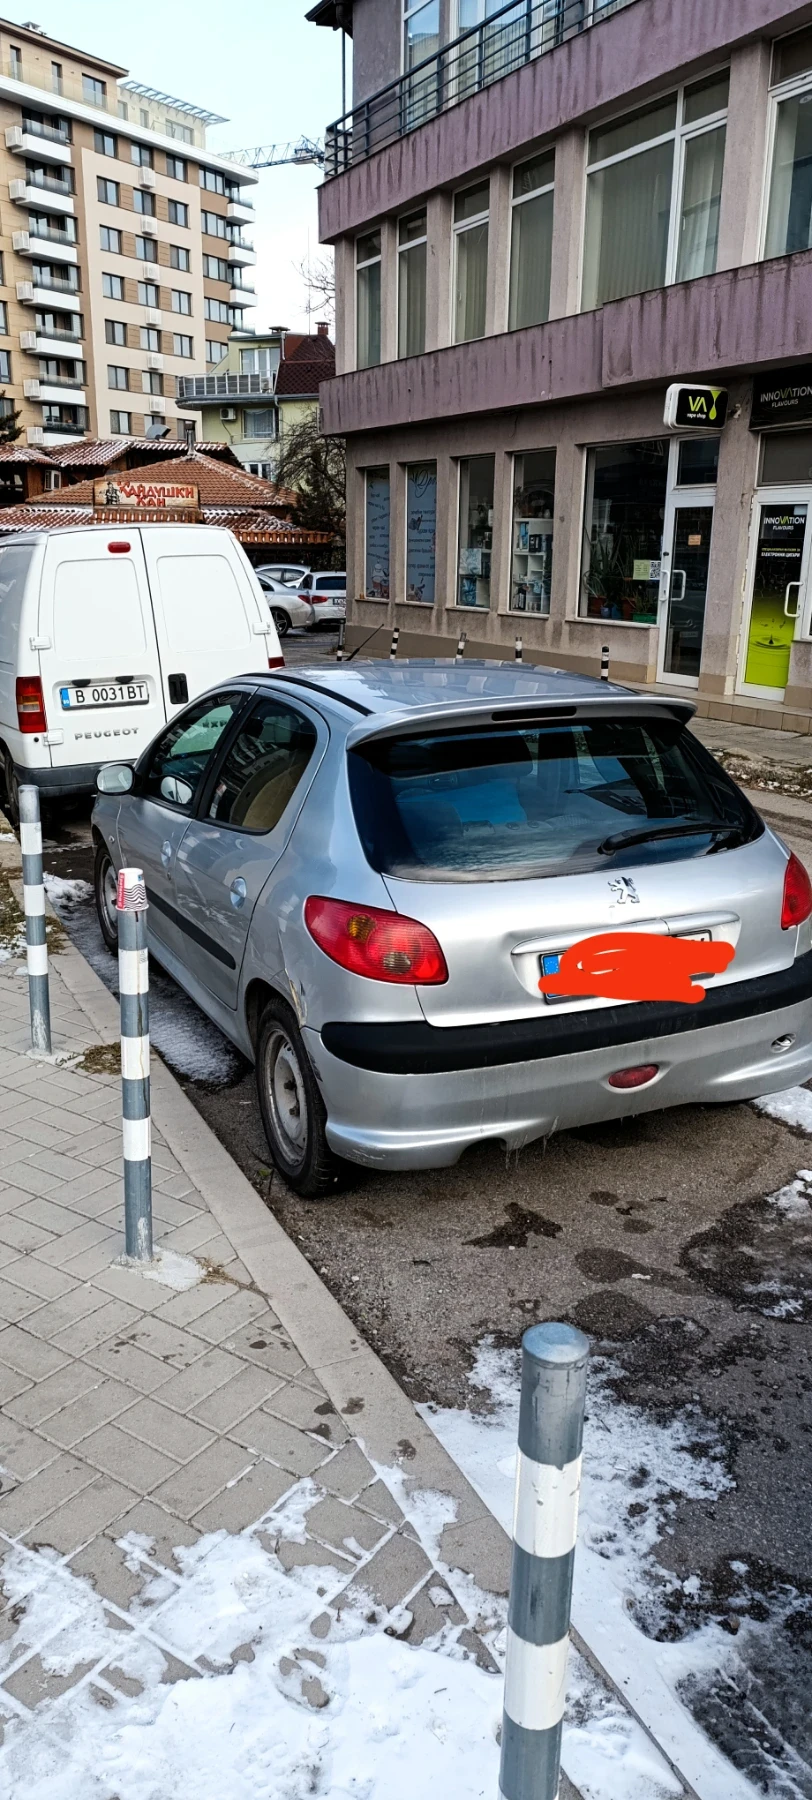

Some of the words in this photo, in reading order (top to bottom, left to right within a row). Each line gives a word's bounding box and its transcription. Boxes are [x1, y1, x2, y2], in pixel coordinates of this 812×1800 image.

[760, 386, 812, 402] INNOVATION
[688, 396, 707, 412] VA
[771, 398, 799, 408] FLAVOURS
[763, 515, 805, 524] INNOVATION
[75, 689, 85, 703] B
[74, 727, 139, 740] PEUGEOT
